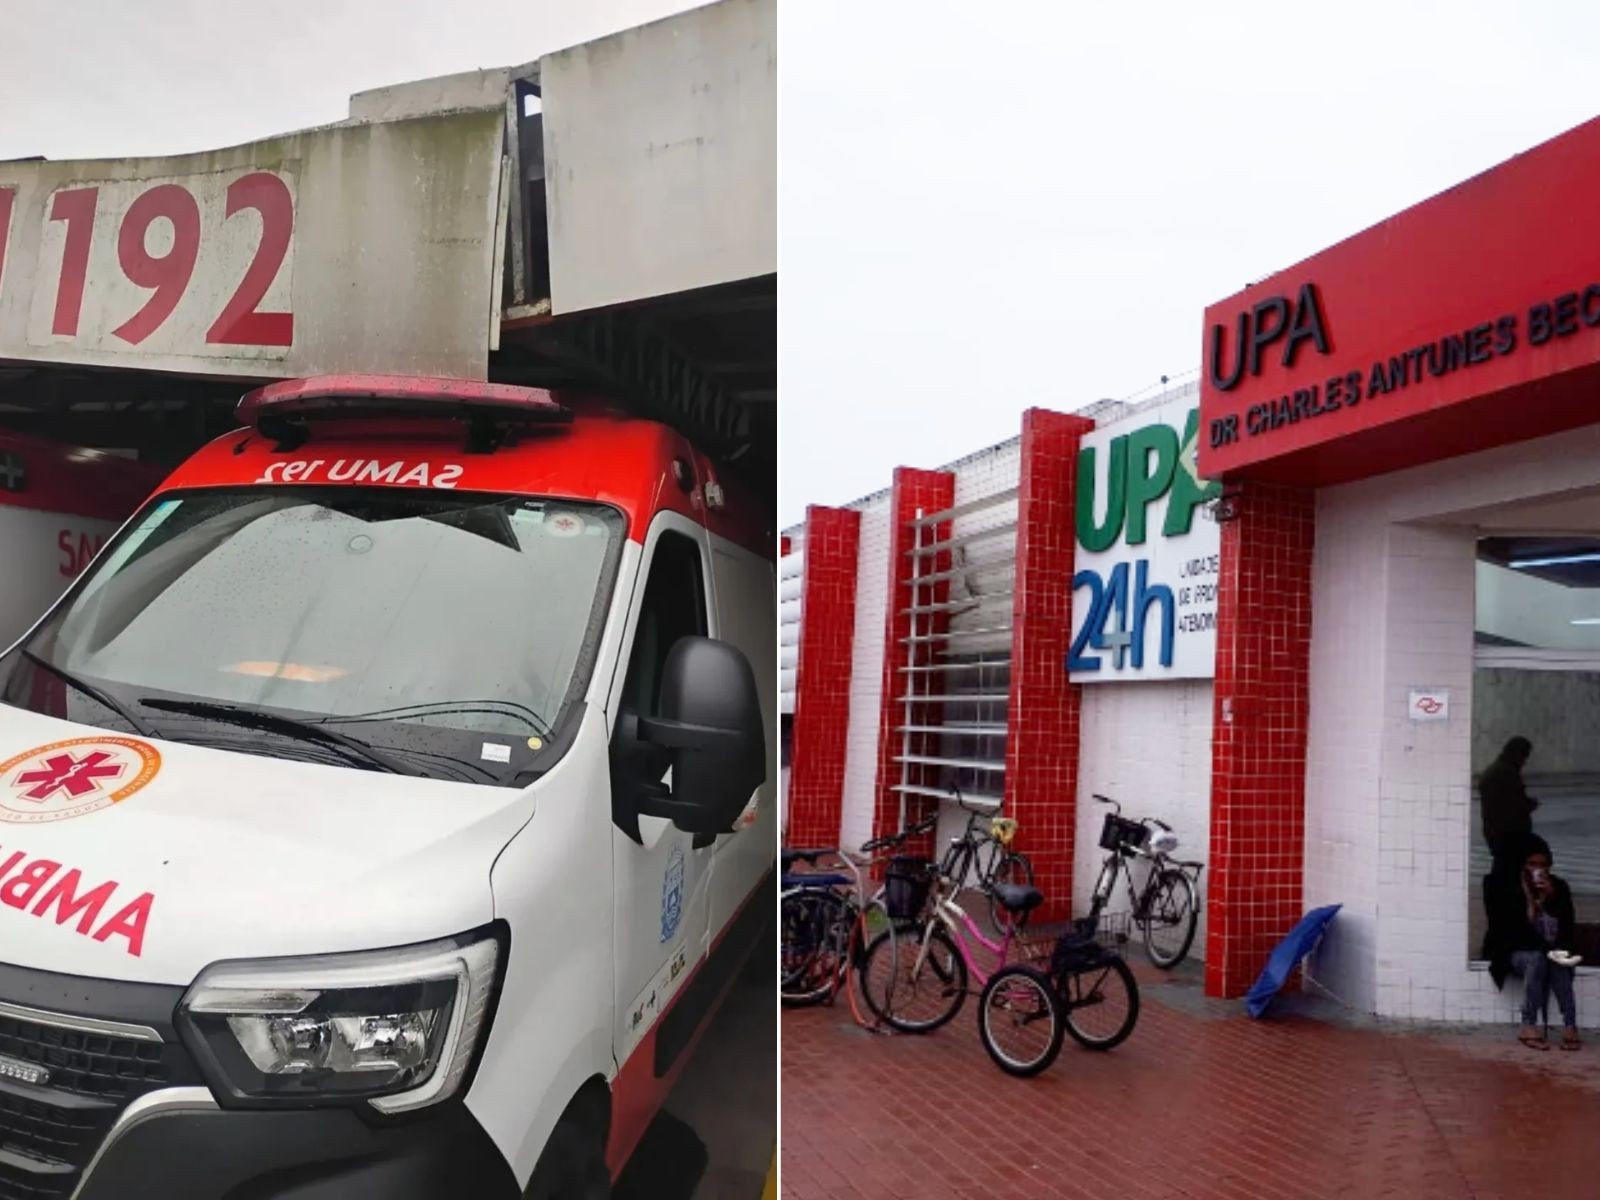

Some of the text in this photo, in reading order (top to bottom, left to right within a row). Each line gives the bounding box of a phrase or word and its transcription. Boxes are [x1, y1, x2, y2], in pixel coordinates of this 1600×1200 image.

[49, 172, 294, 347] 192
[1210, 282, 1330, 390] UPA
[1210, 413, 1239, 447] DR
[1245, 369, 1362, 435] CHARLES
[1366, 314, 1517, 398] ANTUNES
[1065, 559, 1175, 671] 24h
